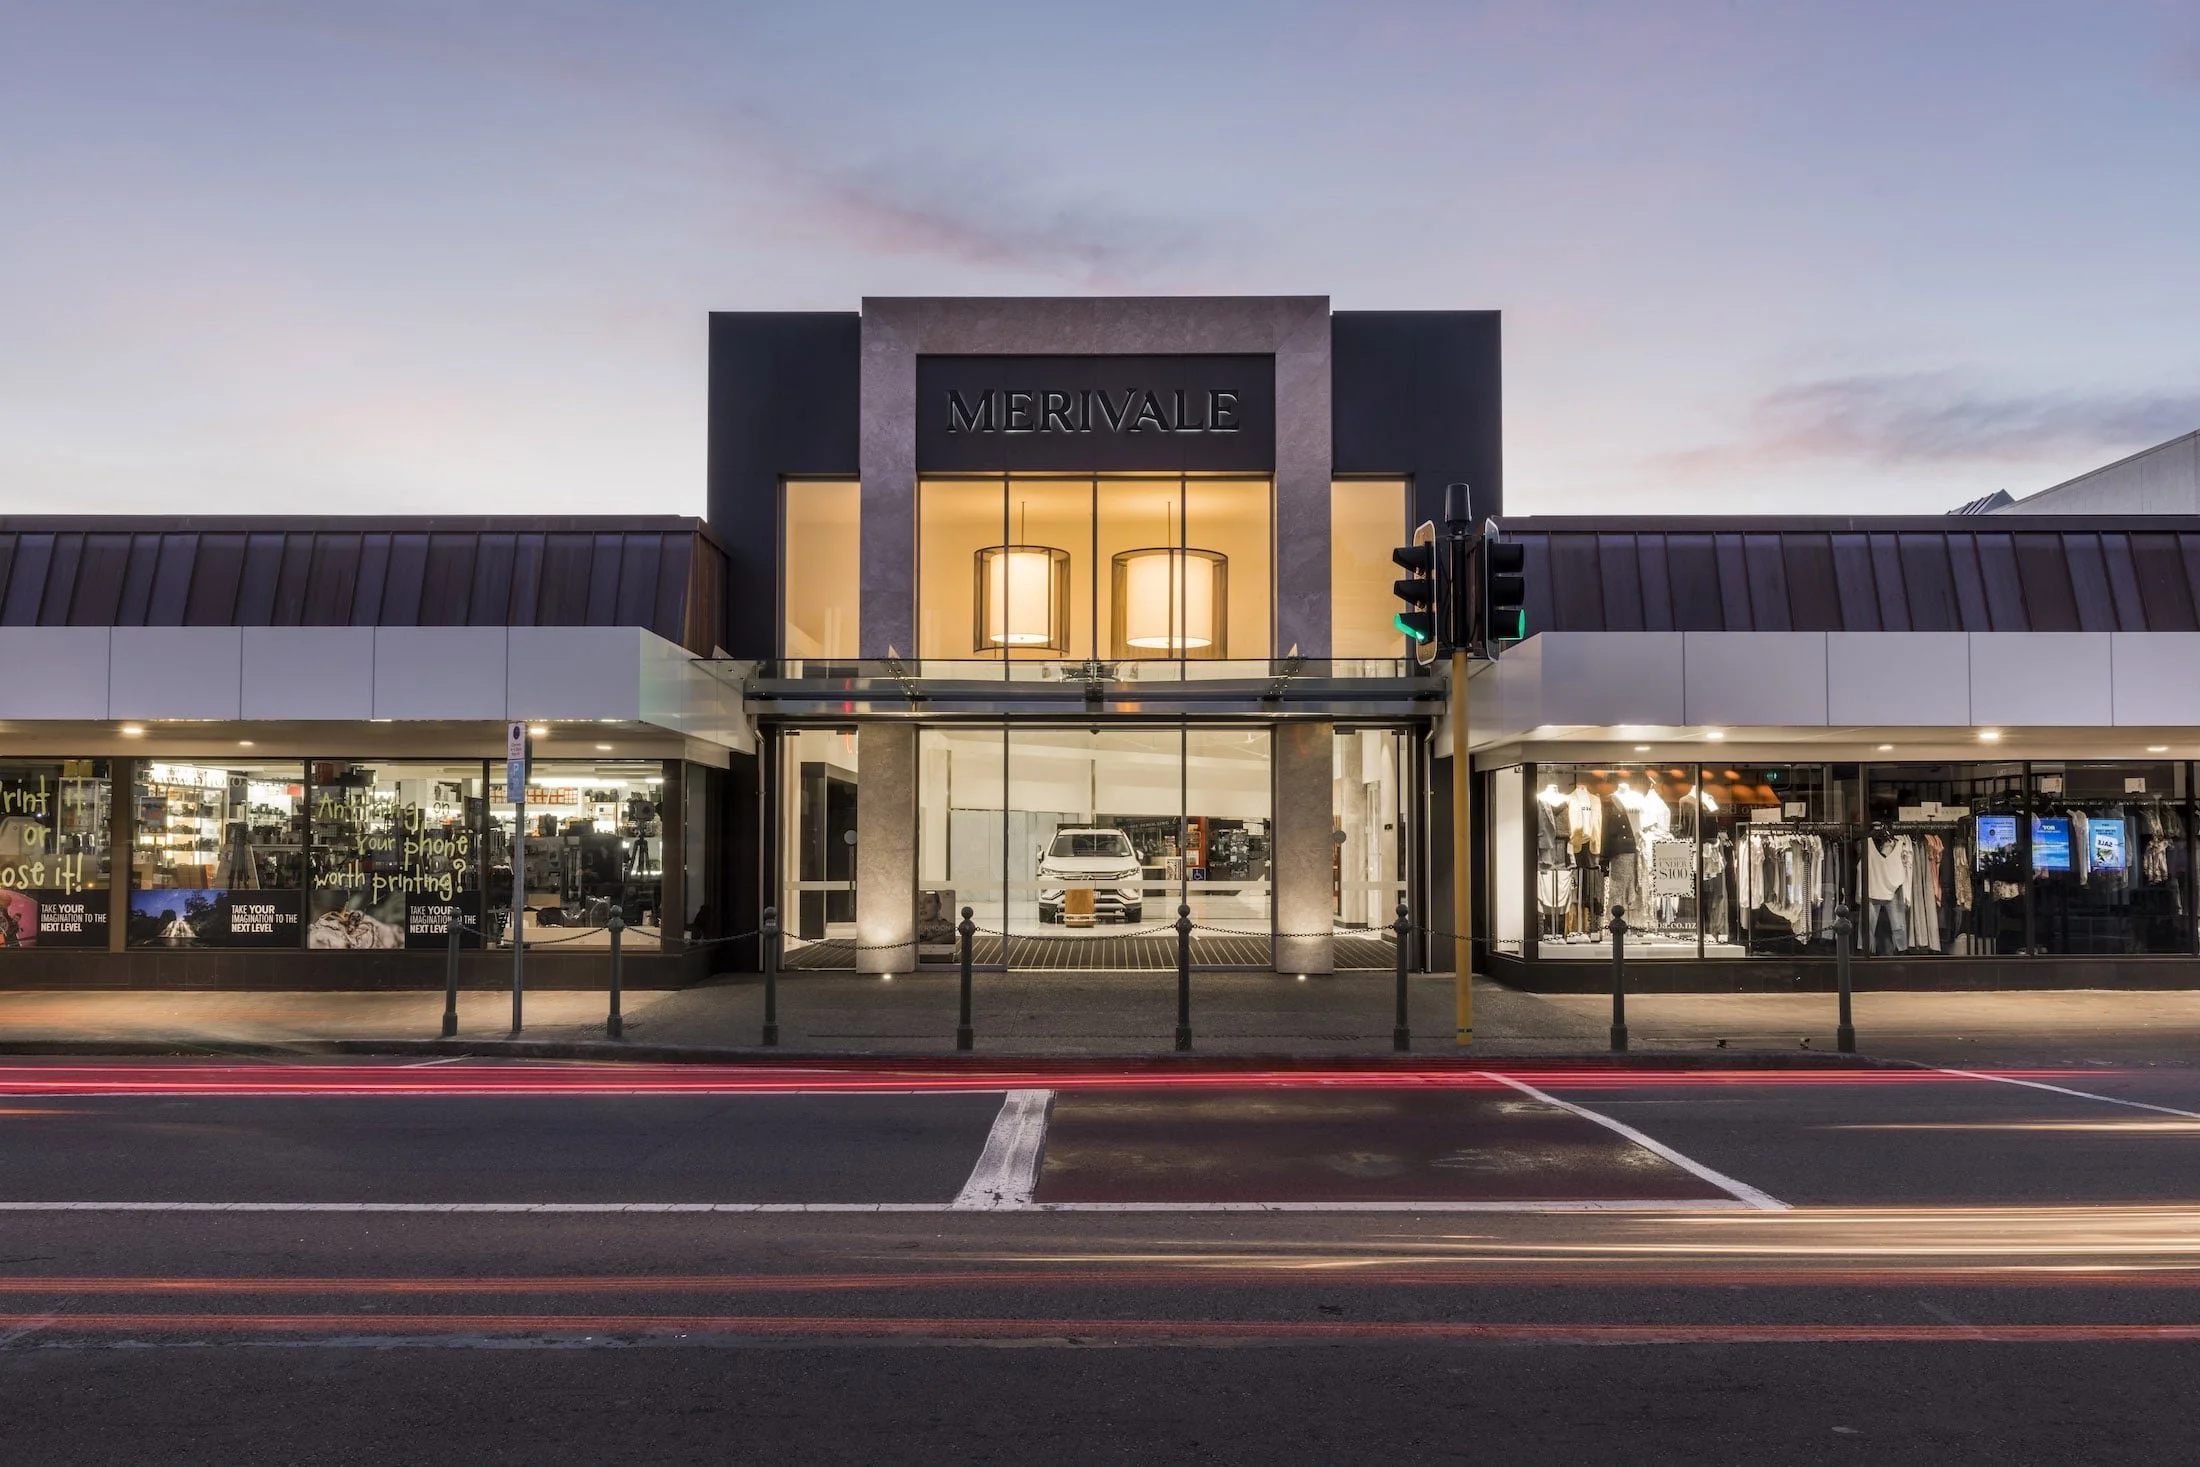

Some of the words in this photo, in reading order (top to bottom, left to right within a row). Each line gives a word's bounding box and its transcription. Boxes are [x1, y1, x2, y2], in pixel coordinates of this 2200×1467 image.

[946, 388, 1240, 433] MERIVALE
[433, 801, 450, 815] on
[24, 826, 51, 848] or
[404, 820, 468, 871] phone
[0, 861, 45, 890] ose
[55, 852, 83, 896] it!
[1659, 868, 1688, 880] $100
[314, 859, 365, 891] worth
[372, 858, 467, 905] printing?
[41, 904, 57, 913] TAKE
[58, 904, 84, 913] YOUR
[231, 905, 248, 914] TAKE
[249, 905, 275, 914] YOUR
[410, 906, 427, 915] TAKE
[41, 914, 83, 923] IMAGINATION
[84, 914, 93, 922] TO
[94, 914, 107, 923] THE
[231, 914, 274, 923] IMAGINATION
[275, 914, 284, 923] TO
[285, 914, 298, 923] THE
[463, 915, 477, 924] THE
[41, 923, 60, 932] NEXT
[61, 923, 82, 932] LEVEL
[231, 924, 251, 933] NEXT
[252, 924, 273, 933] LEVEL
[410, 925, 429, 934] NEXT
[430, 925, 448, 934] LEVE
